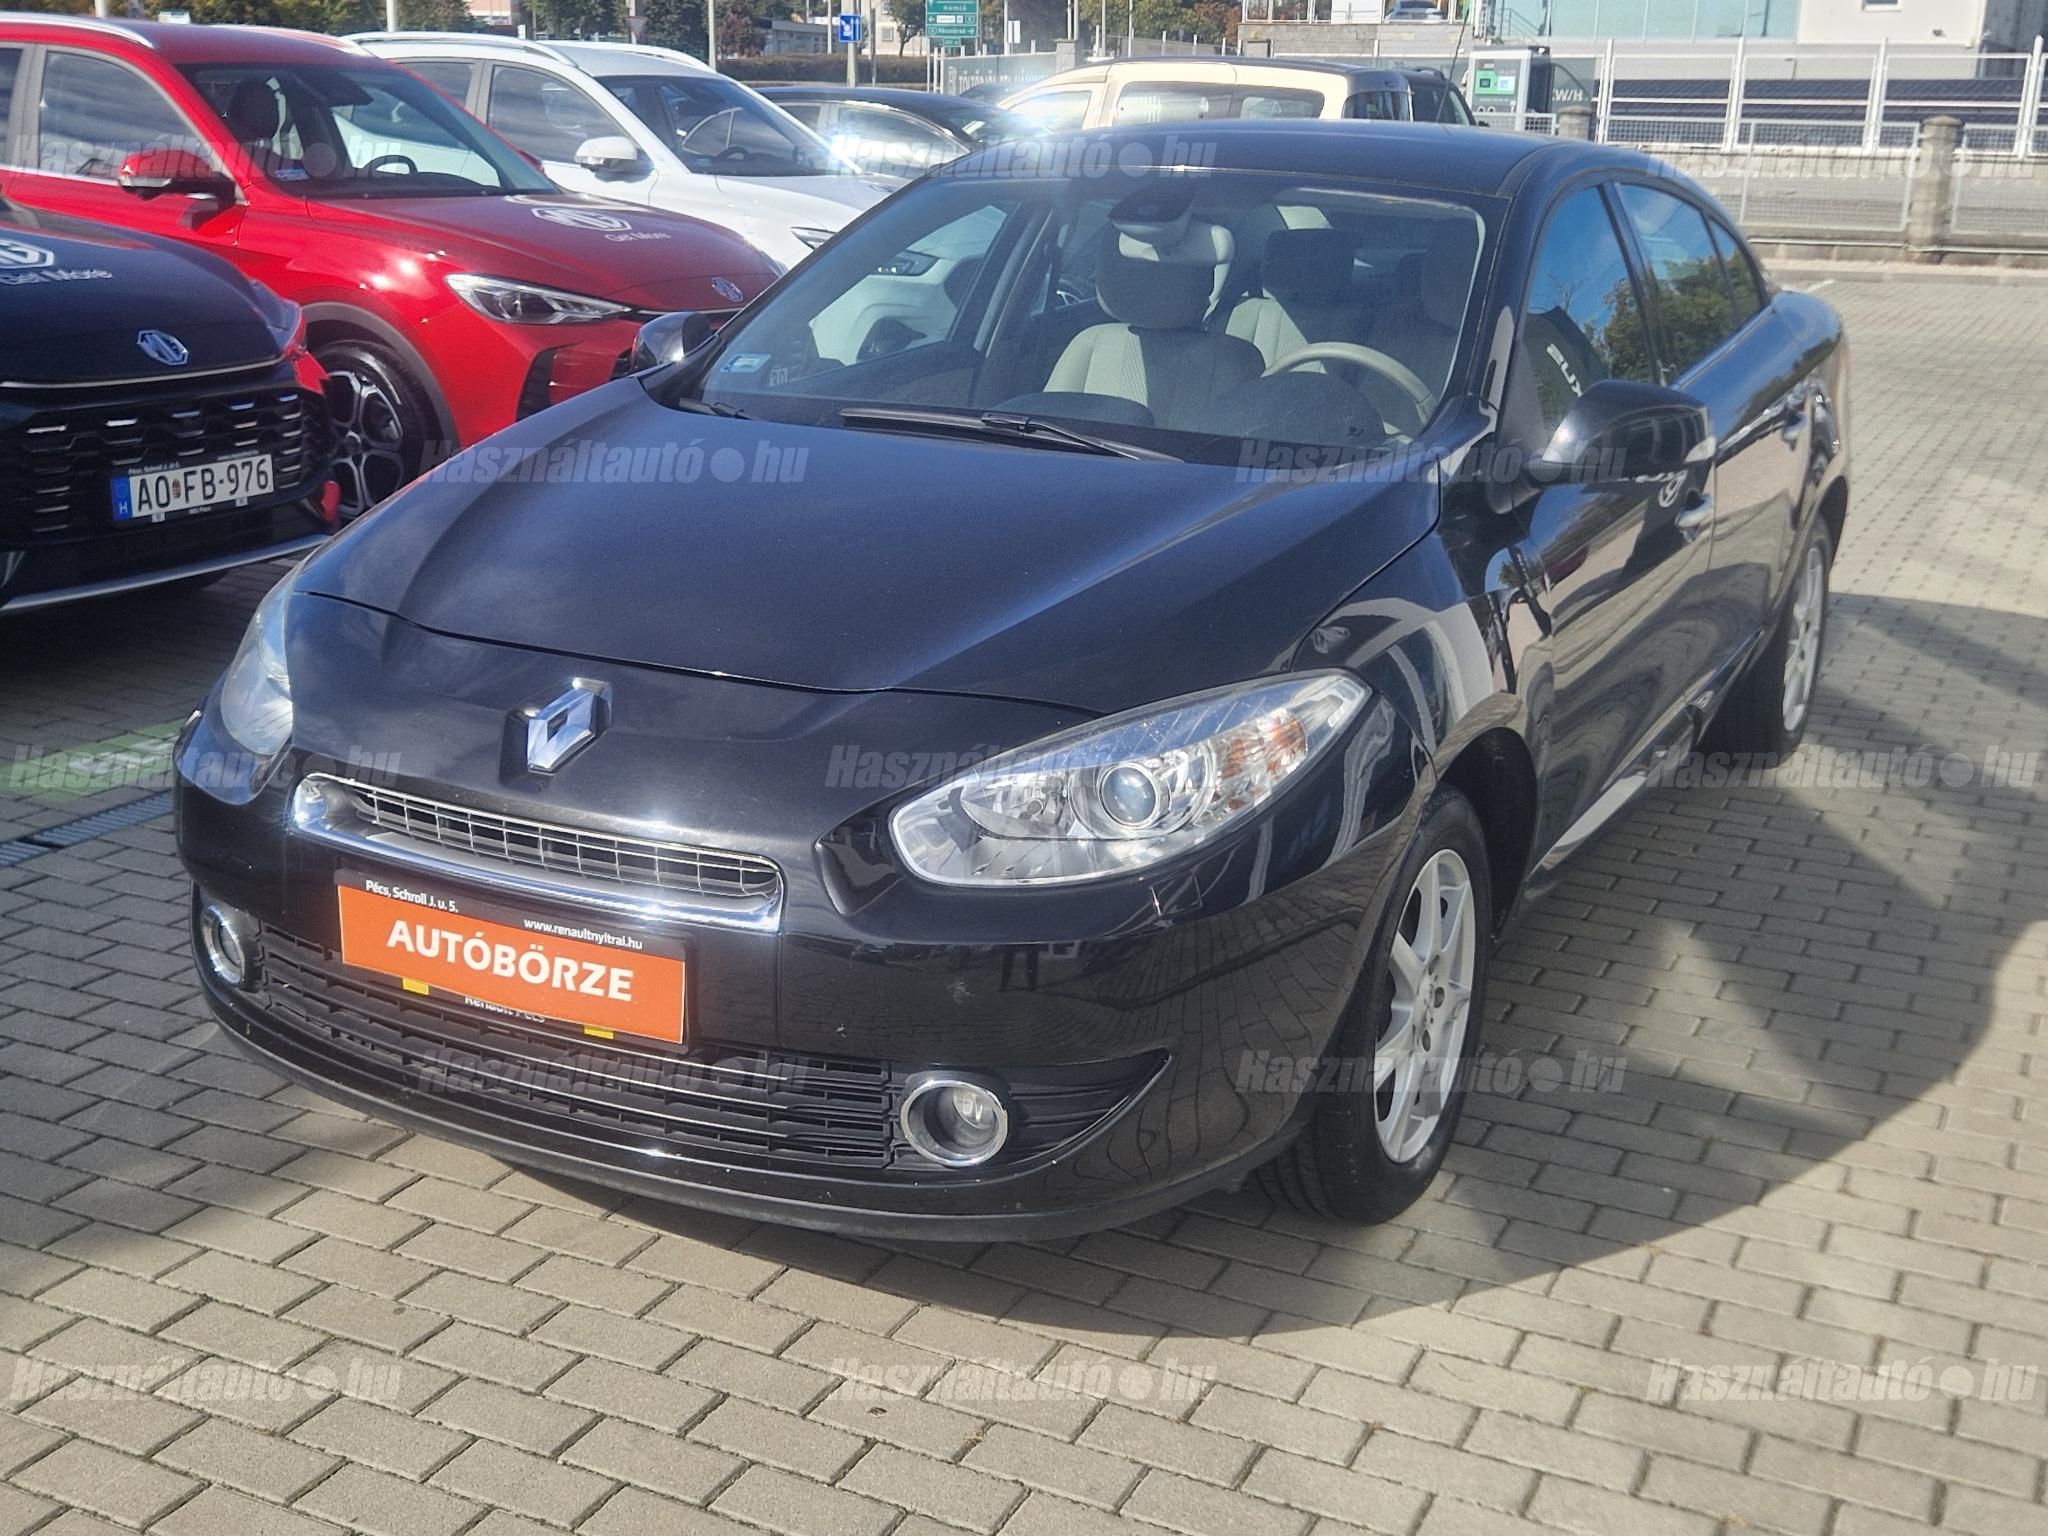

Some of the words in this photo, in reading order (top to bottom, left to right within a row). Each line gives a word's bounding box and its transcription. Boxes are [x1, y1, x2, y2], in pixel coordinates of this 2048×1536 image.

[119, 502, 129, 514] H
[365, 879, 392, 898] Pécs,
[392, 886, 427, 905] Schroll
[523, 919, 643, 950] www.renaultnyitrai.hu
[386, 919, 634, 1002] AUTÓBÖRZE
